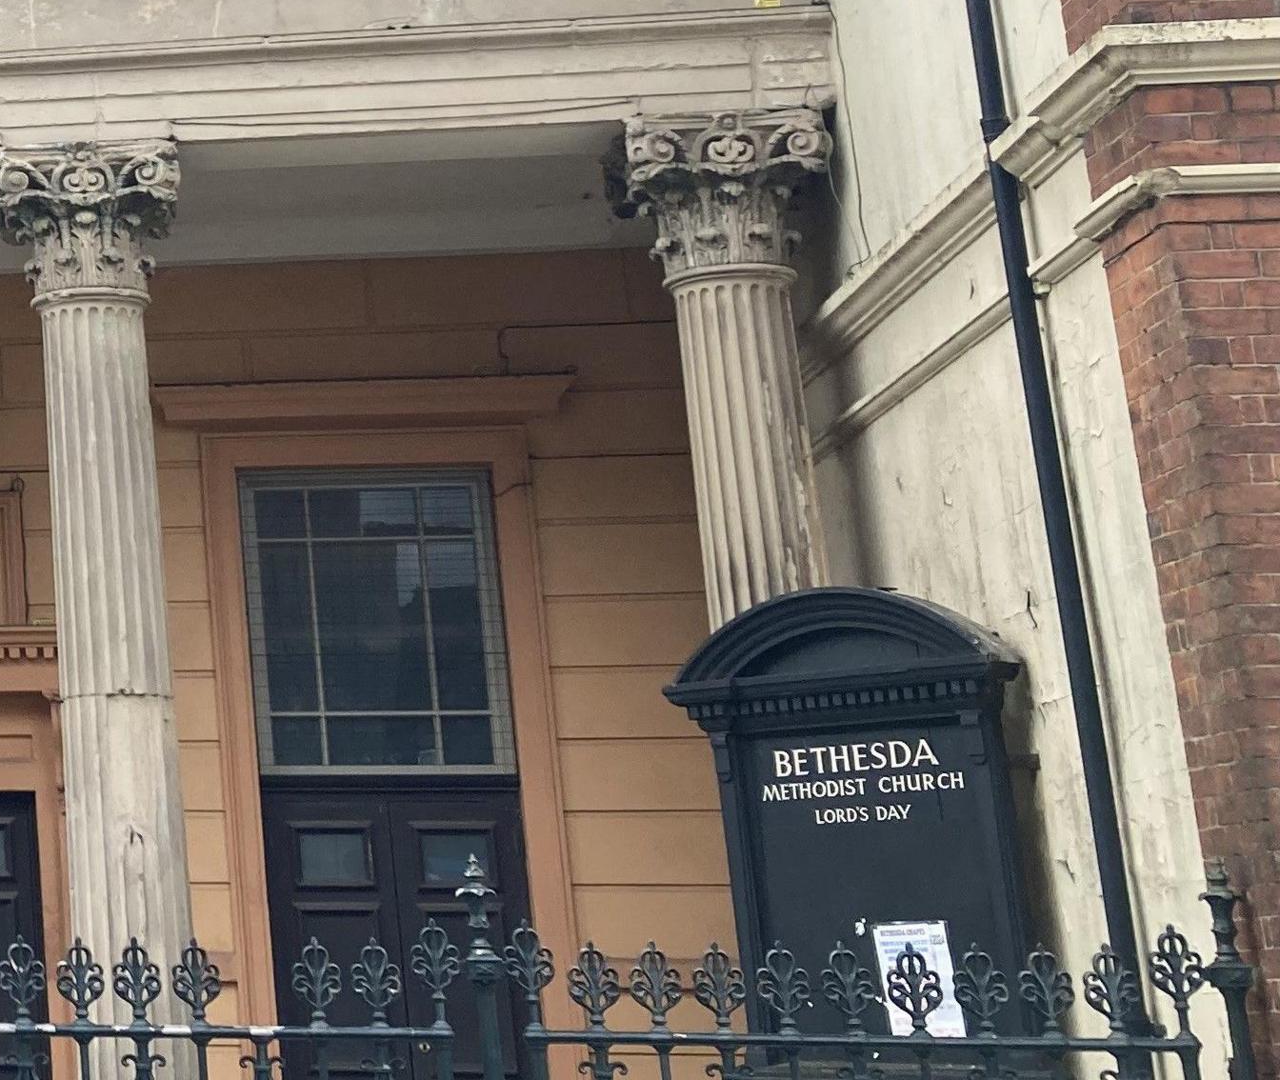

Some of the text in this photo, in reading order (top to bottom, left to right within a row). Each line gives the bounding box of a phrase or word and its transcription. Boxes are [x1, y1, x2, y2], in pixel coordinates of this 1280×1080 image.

[772, 738, 940, 778] BETHESDA
[762, 771, 965, 802] METHODIST CHURCH
[814, 804, 912, 825] LORD'S DAY
